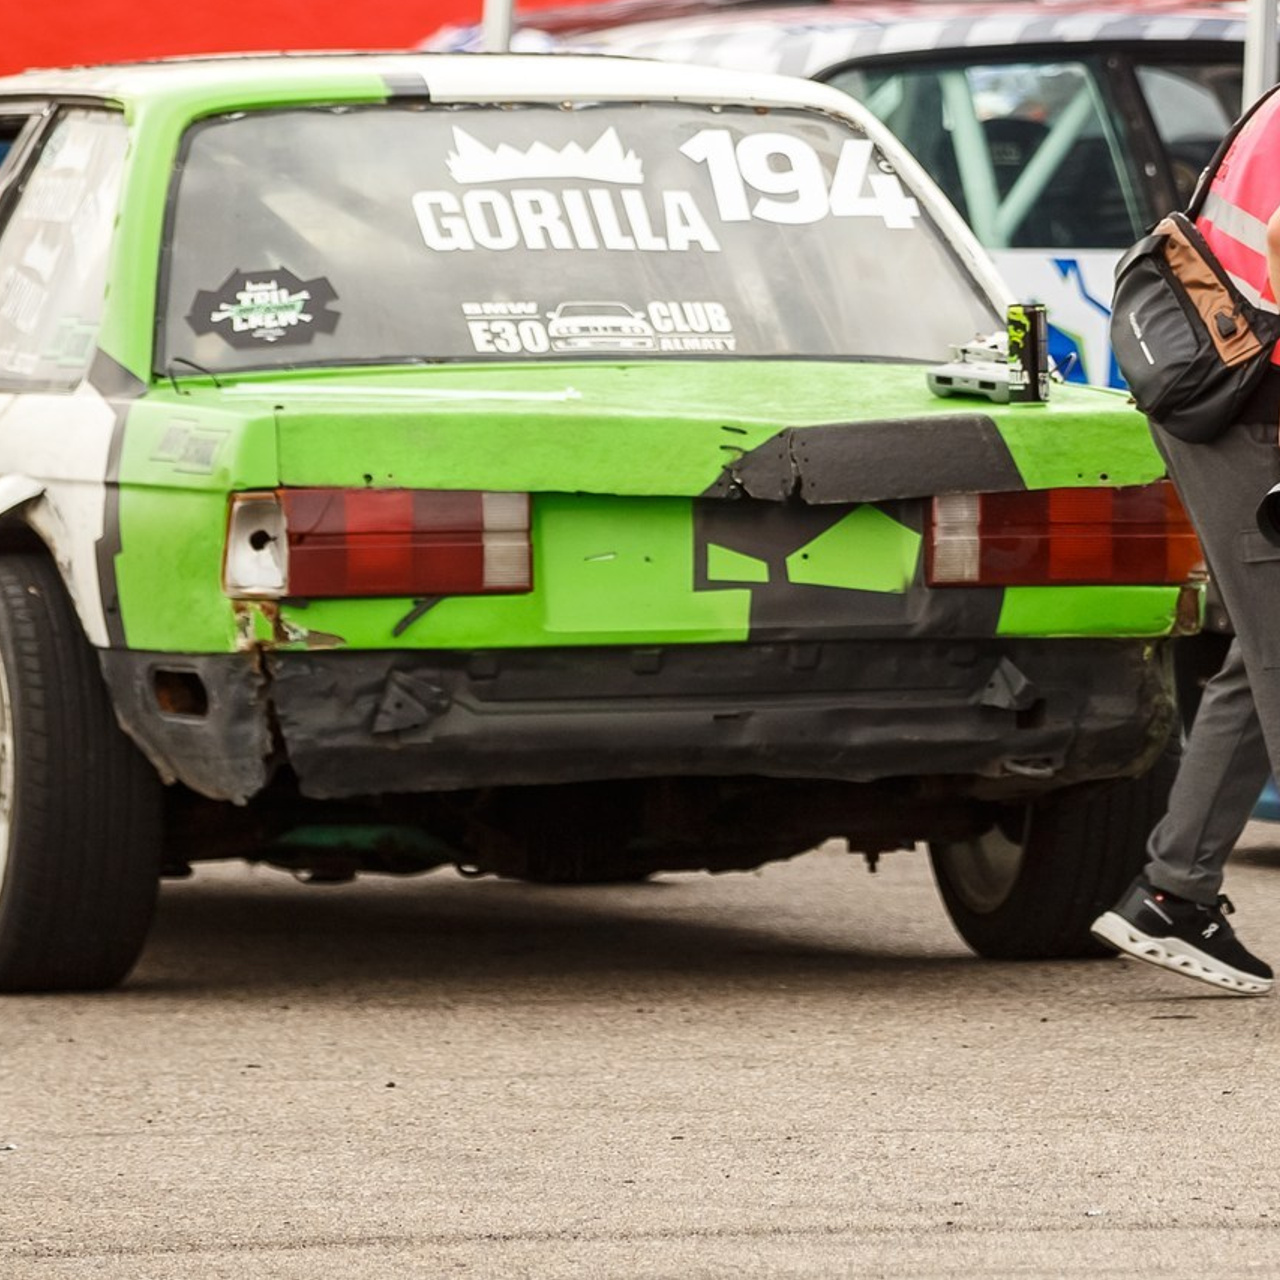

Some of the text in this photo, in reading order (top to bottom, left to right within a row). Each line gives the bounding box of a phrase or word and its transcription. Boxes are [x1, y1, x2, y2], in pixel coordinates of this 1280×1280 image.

[679, 129, 921, 229] 194
[411, 189, 721, 252] GORILLA
[461, 302, 538, 315] BMW
[647, 301, 733, 332] CLUB
[467, 320, 550, 353] E30
[658, 338, 737, 351] ALMATY
